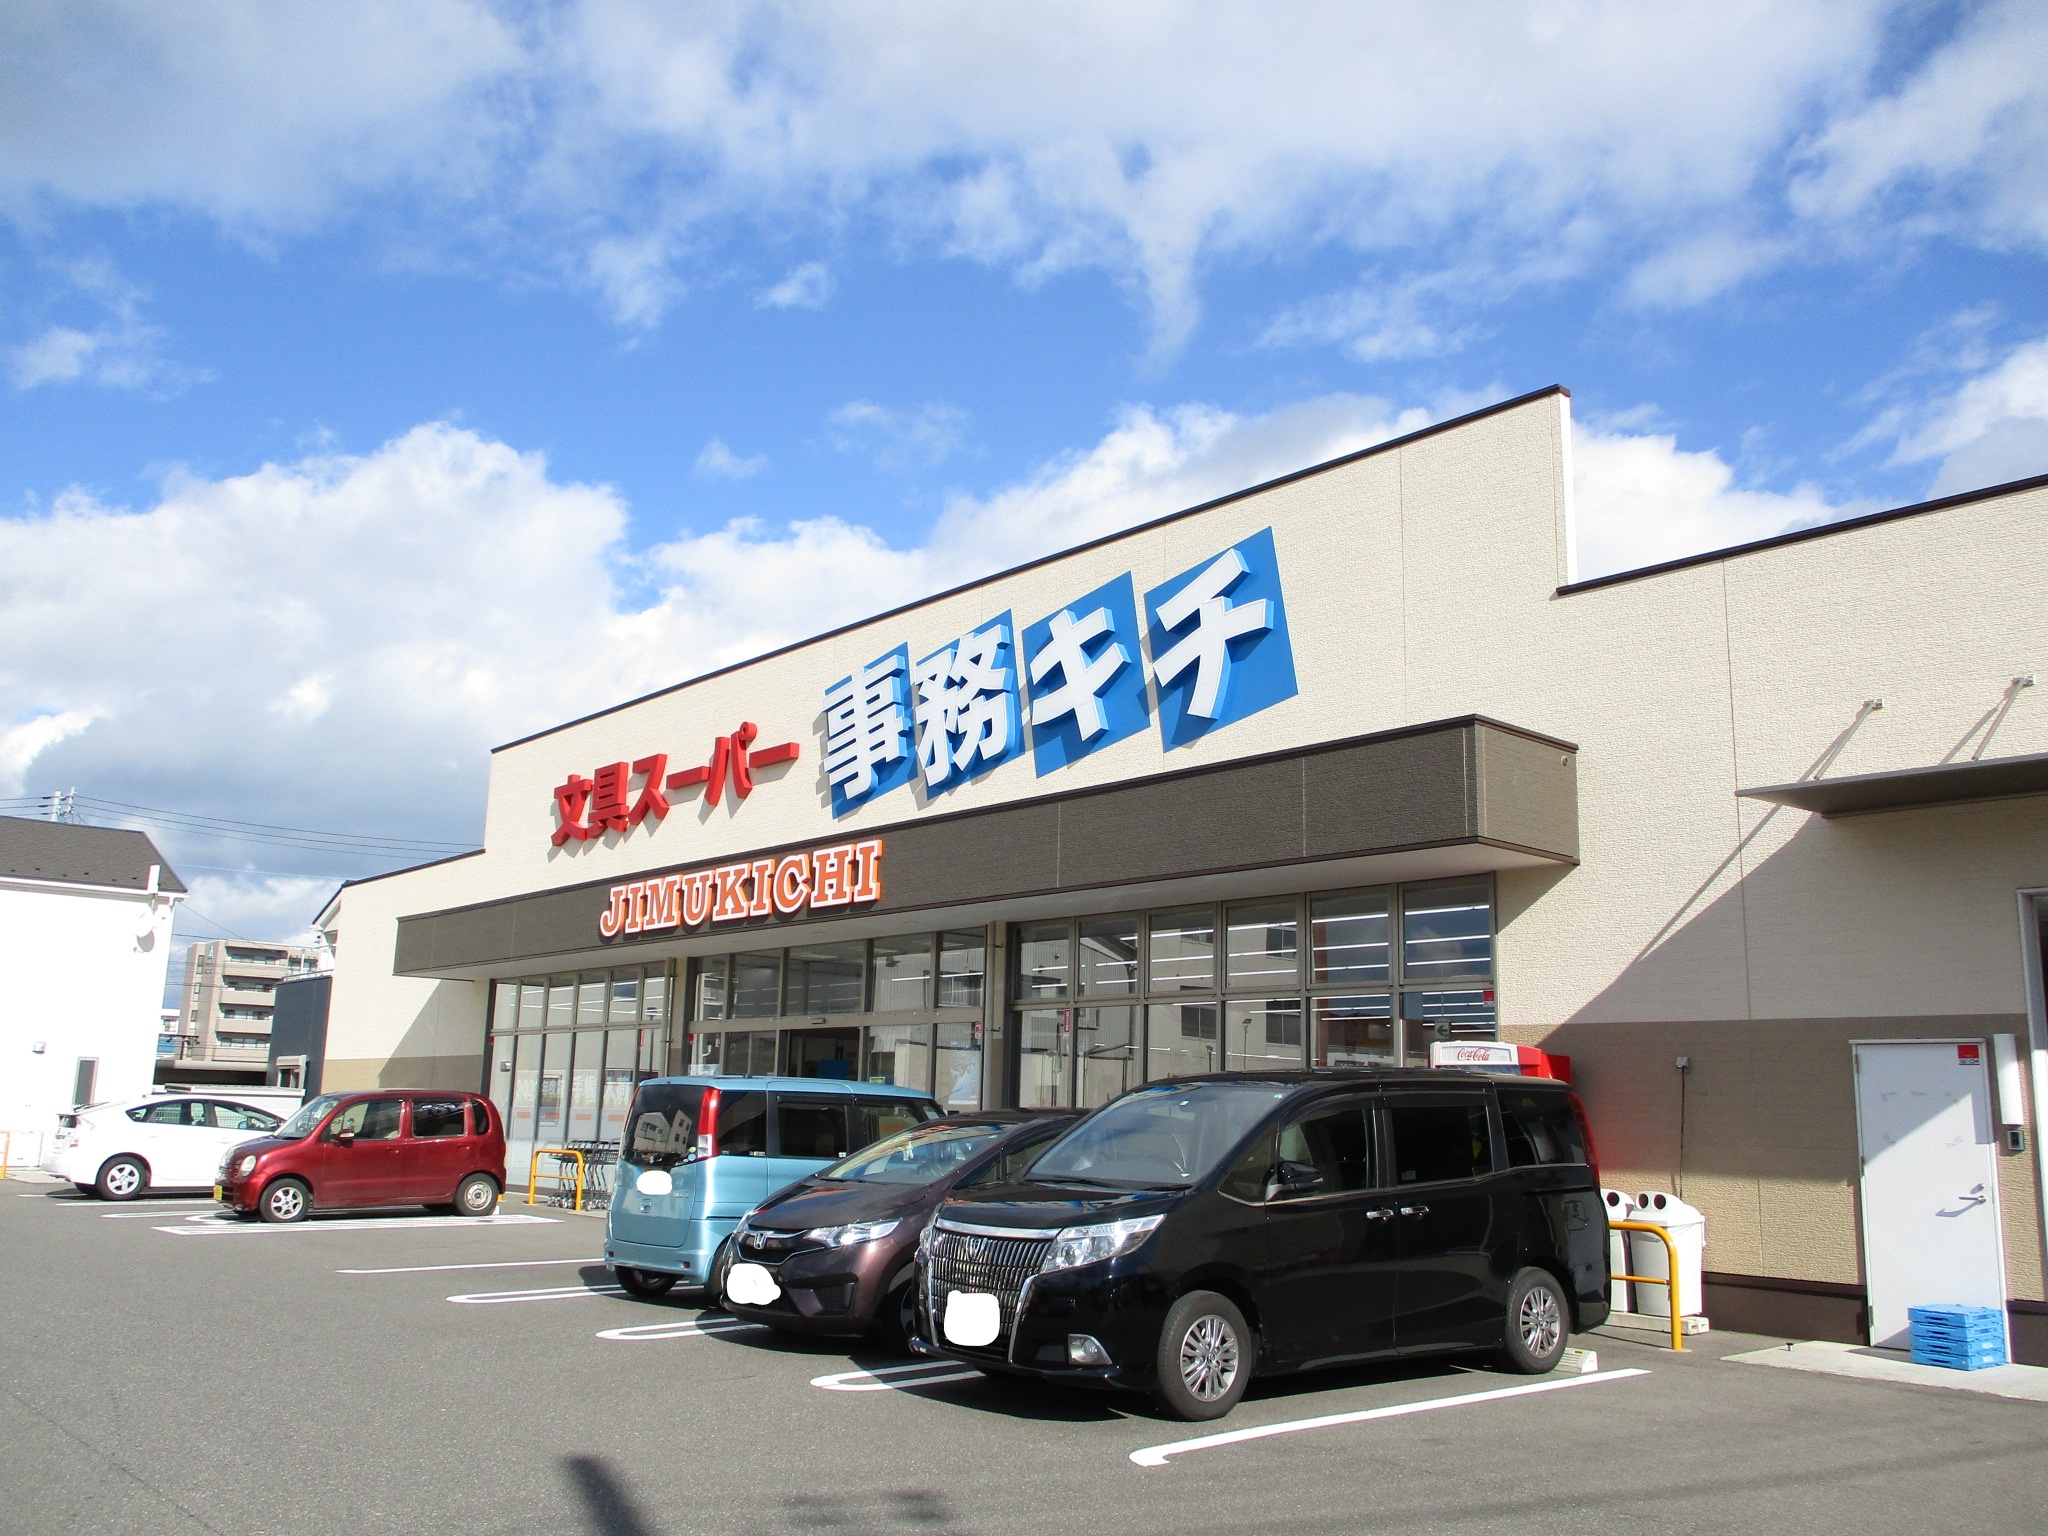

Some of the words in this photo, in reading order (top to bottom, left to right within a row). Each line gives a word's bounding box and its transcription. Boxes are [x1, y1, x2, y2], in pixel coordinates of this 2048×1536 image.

[821, 548, 1274, 800] 事務キチ
[551, 721, 799, 847] 文具スーパー
[600, 839, 883, 938] JIMUKICHI
